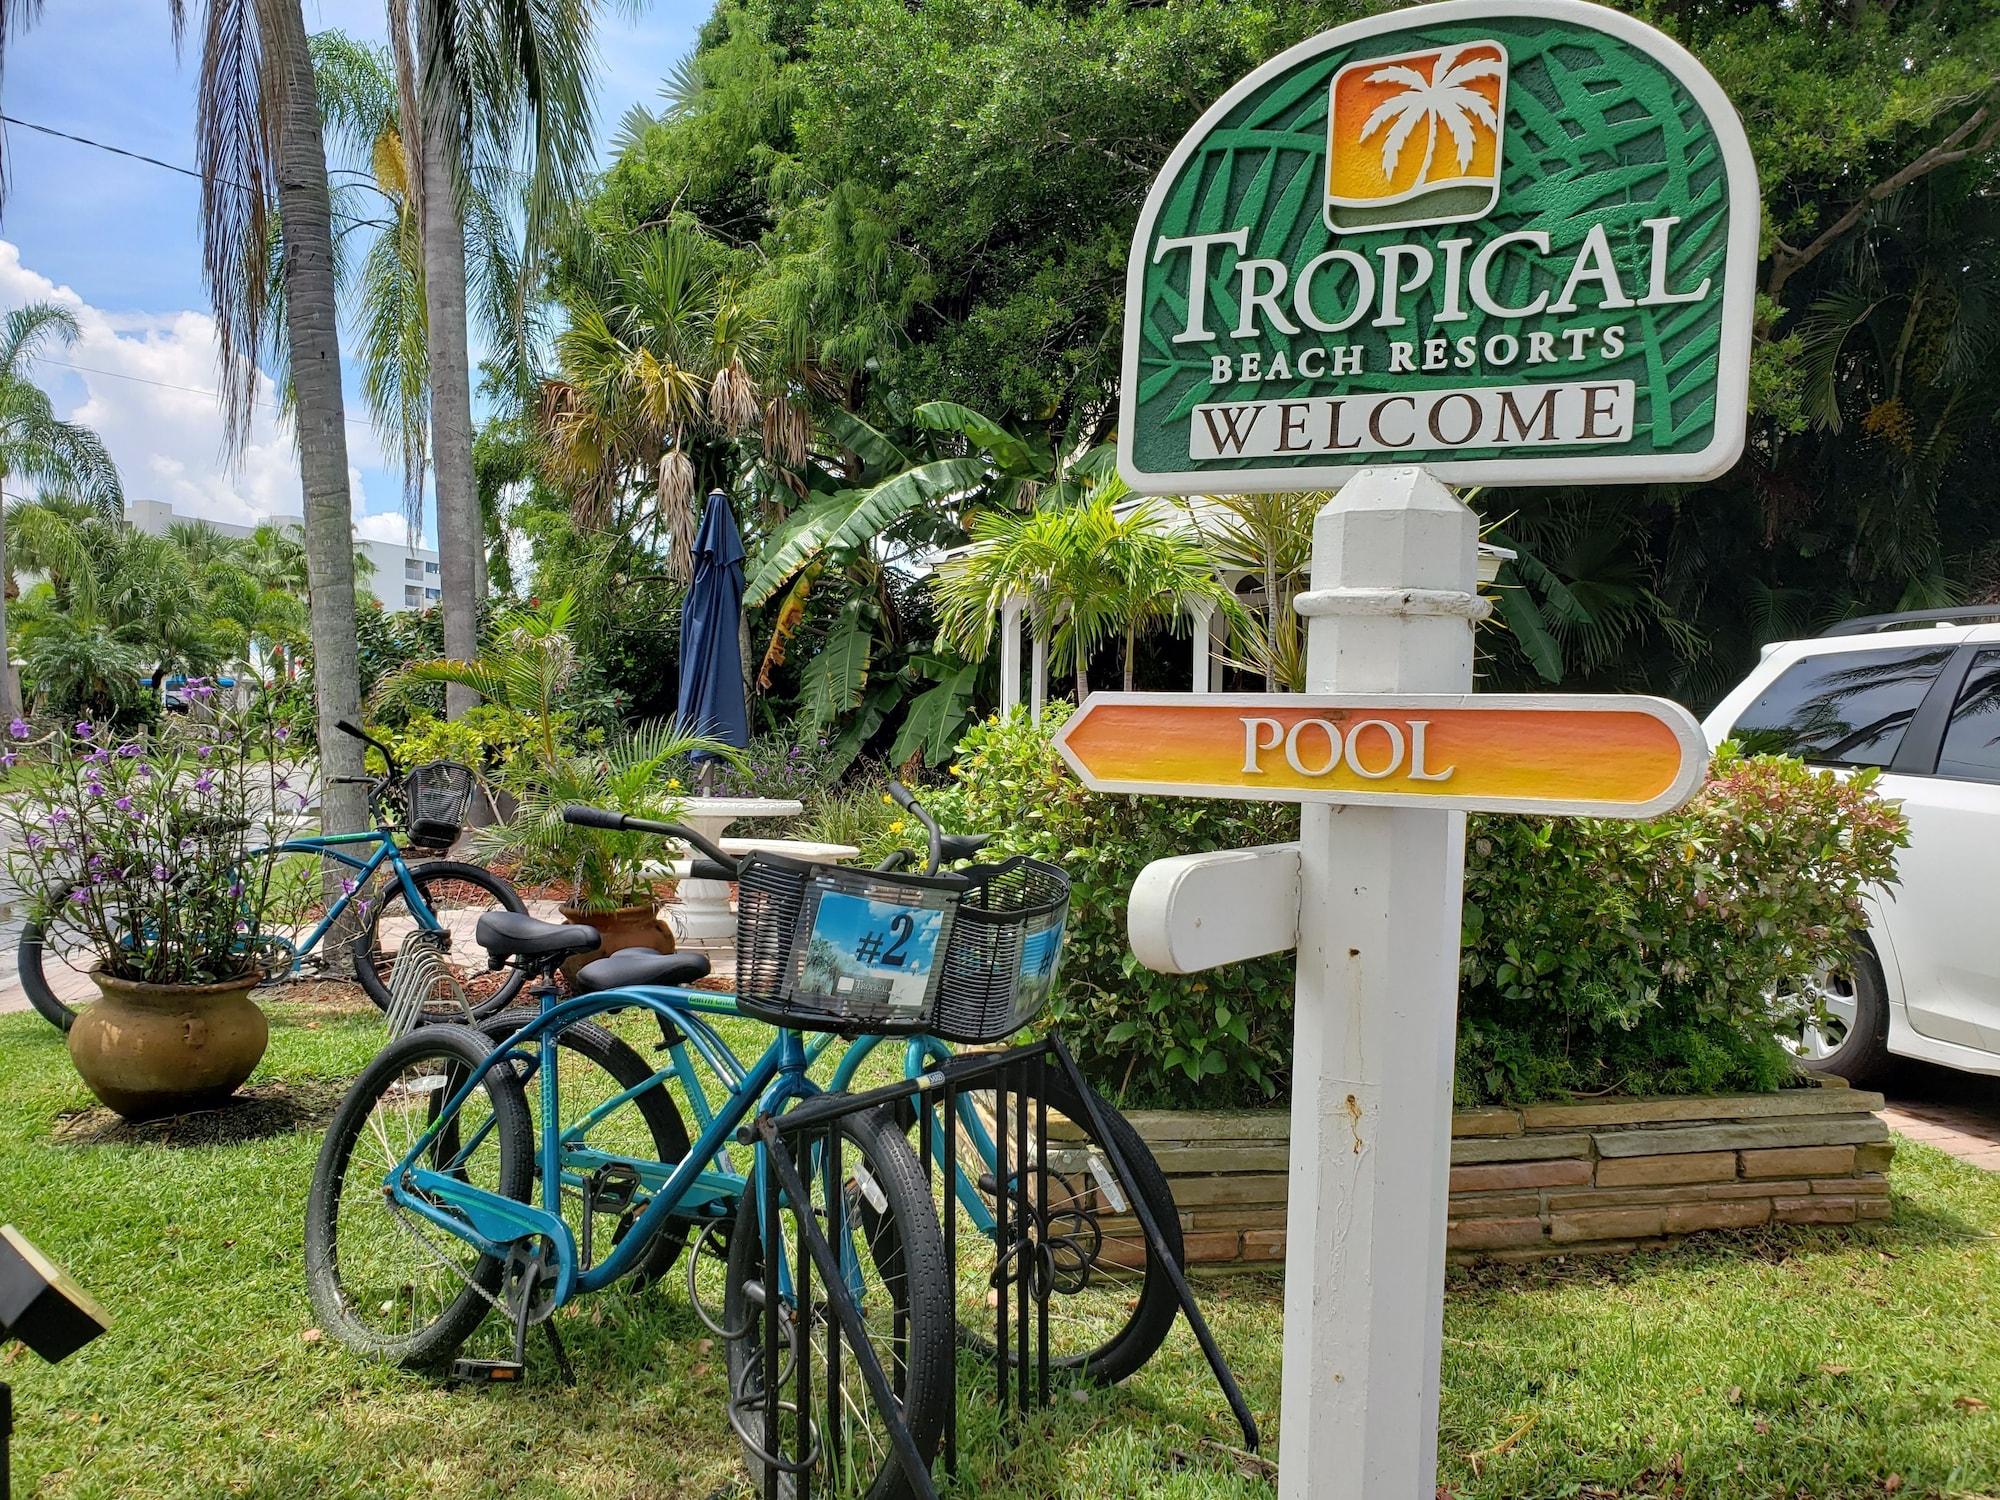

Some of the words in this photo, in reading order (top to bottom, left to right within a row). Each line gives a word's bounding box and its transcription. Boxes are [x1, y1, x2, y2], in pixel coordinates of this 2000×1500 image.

[1152, 216, 1712, 344] TROPICAL
[1209, 344, 1364, 385] BEACH
[1388, 326, 1625, 373] RESORTS
[1198, 385, 1623, 455] WELCOME
[1239, 717, 1456, 782] POOL
[856, 914, 914, 966] #2
